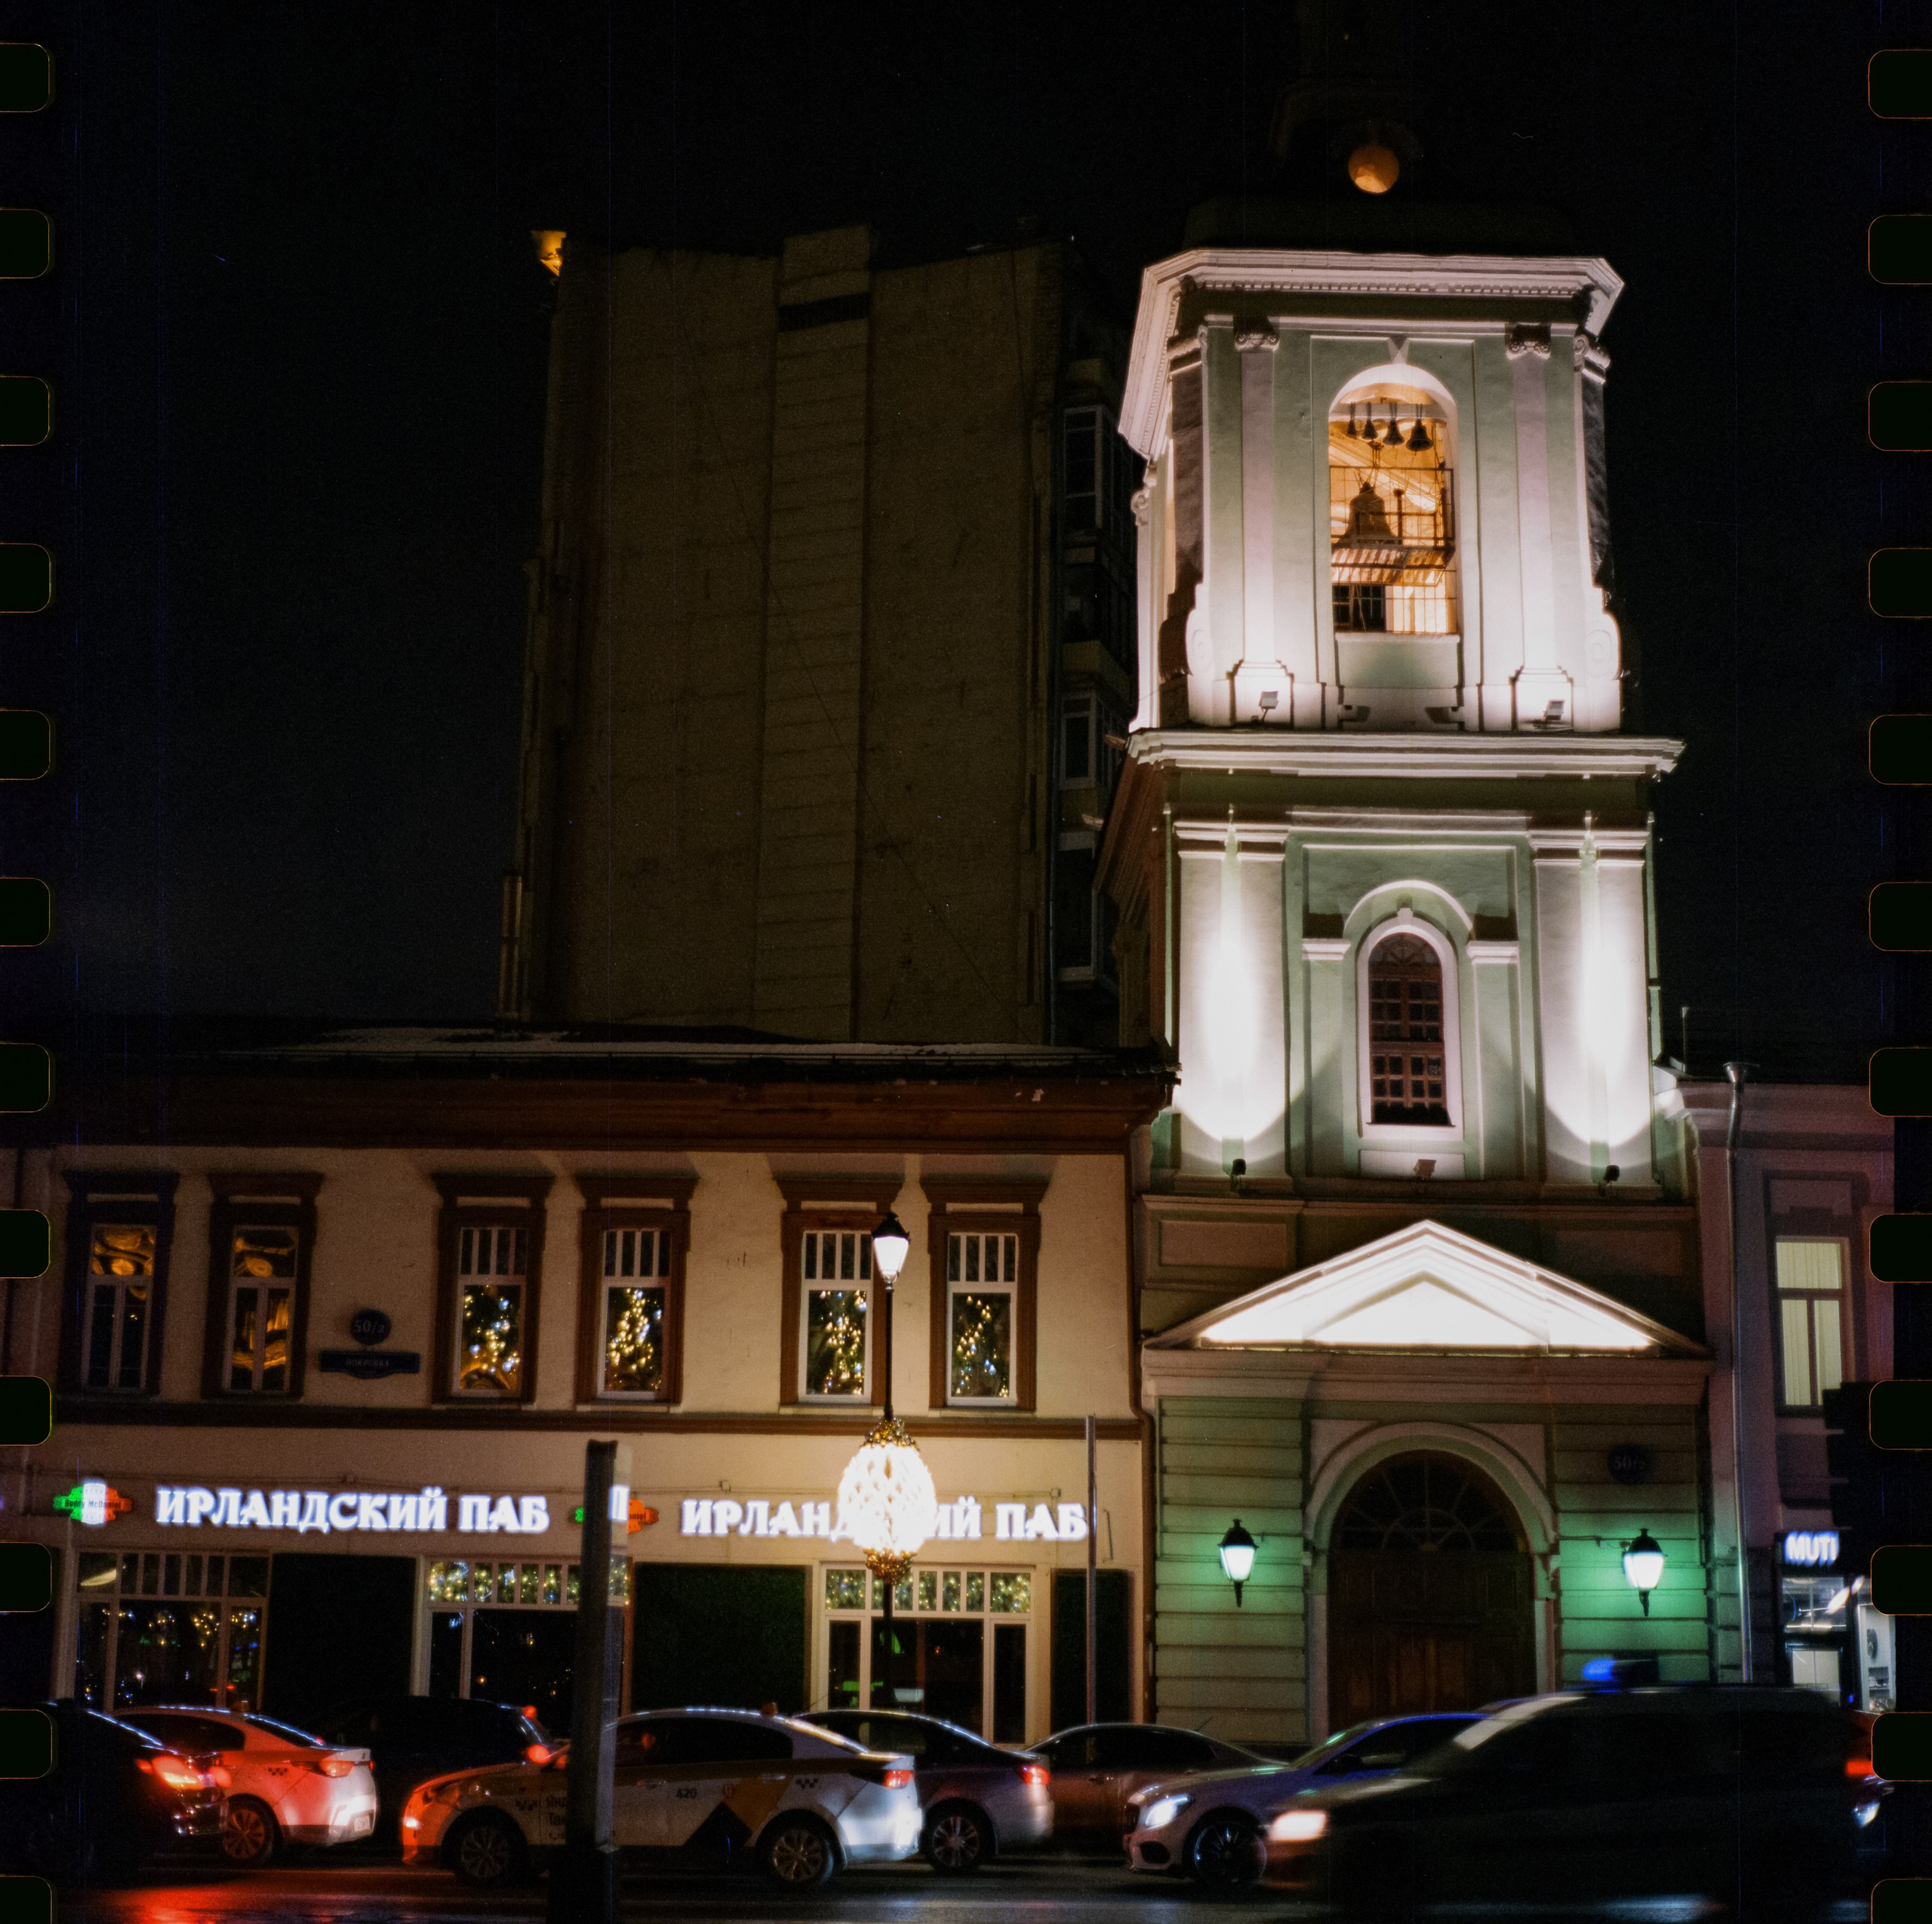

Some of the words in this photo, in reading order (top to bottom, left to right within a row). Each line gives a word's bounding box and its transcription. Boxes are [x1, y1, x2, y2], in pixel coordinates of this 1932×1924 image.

[353, 1320, 386, 1334] 50/2
[156, 1488, 448, 1533] ИРЛАНДСКИЙ
[460, 1495, 550, 1532] ПАБ
[995, 1503, 1088, 1540] ПАБ
